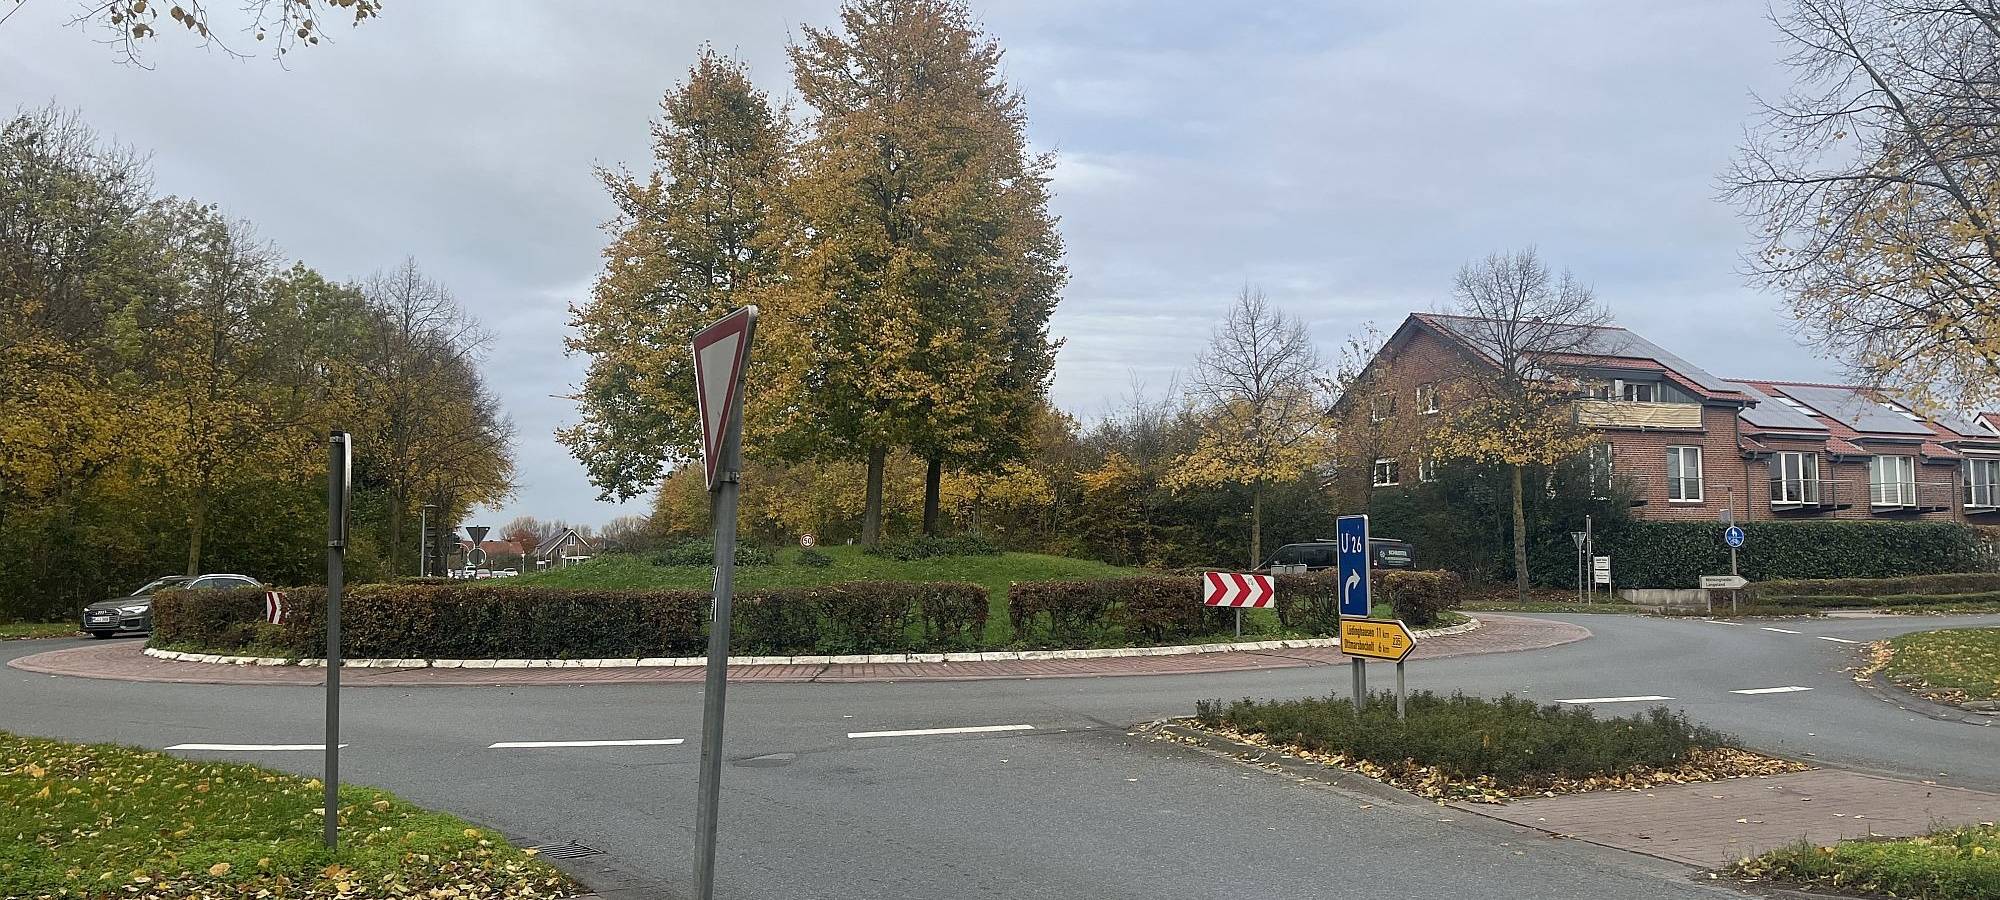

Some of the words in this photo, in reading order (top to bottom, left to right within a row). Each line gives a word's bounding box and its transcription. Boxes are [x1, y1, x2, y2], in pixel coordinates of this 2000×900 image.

[1341, 532, 1349, 553] U
[1352, 536, 1362, 553] 26
[1347, 624, 1375, 638] Lüdinghausen
[1376, 627, 1382, 639] 11
[1383, 630, 1390, 639] km
[1378, 642, 1382, 653] 6
[1383, 645, 1390, 653] km
[1393, 636, 1401, 646] 235
